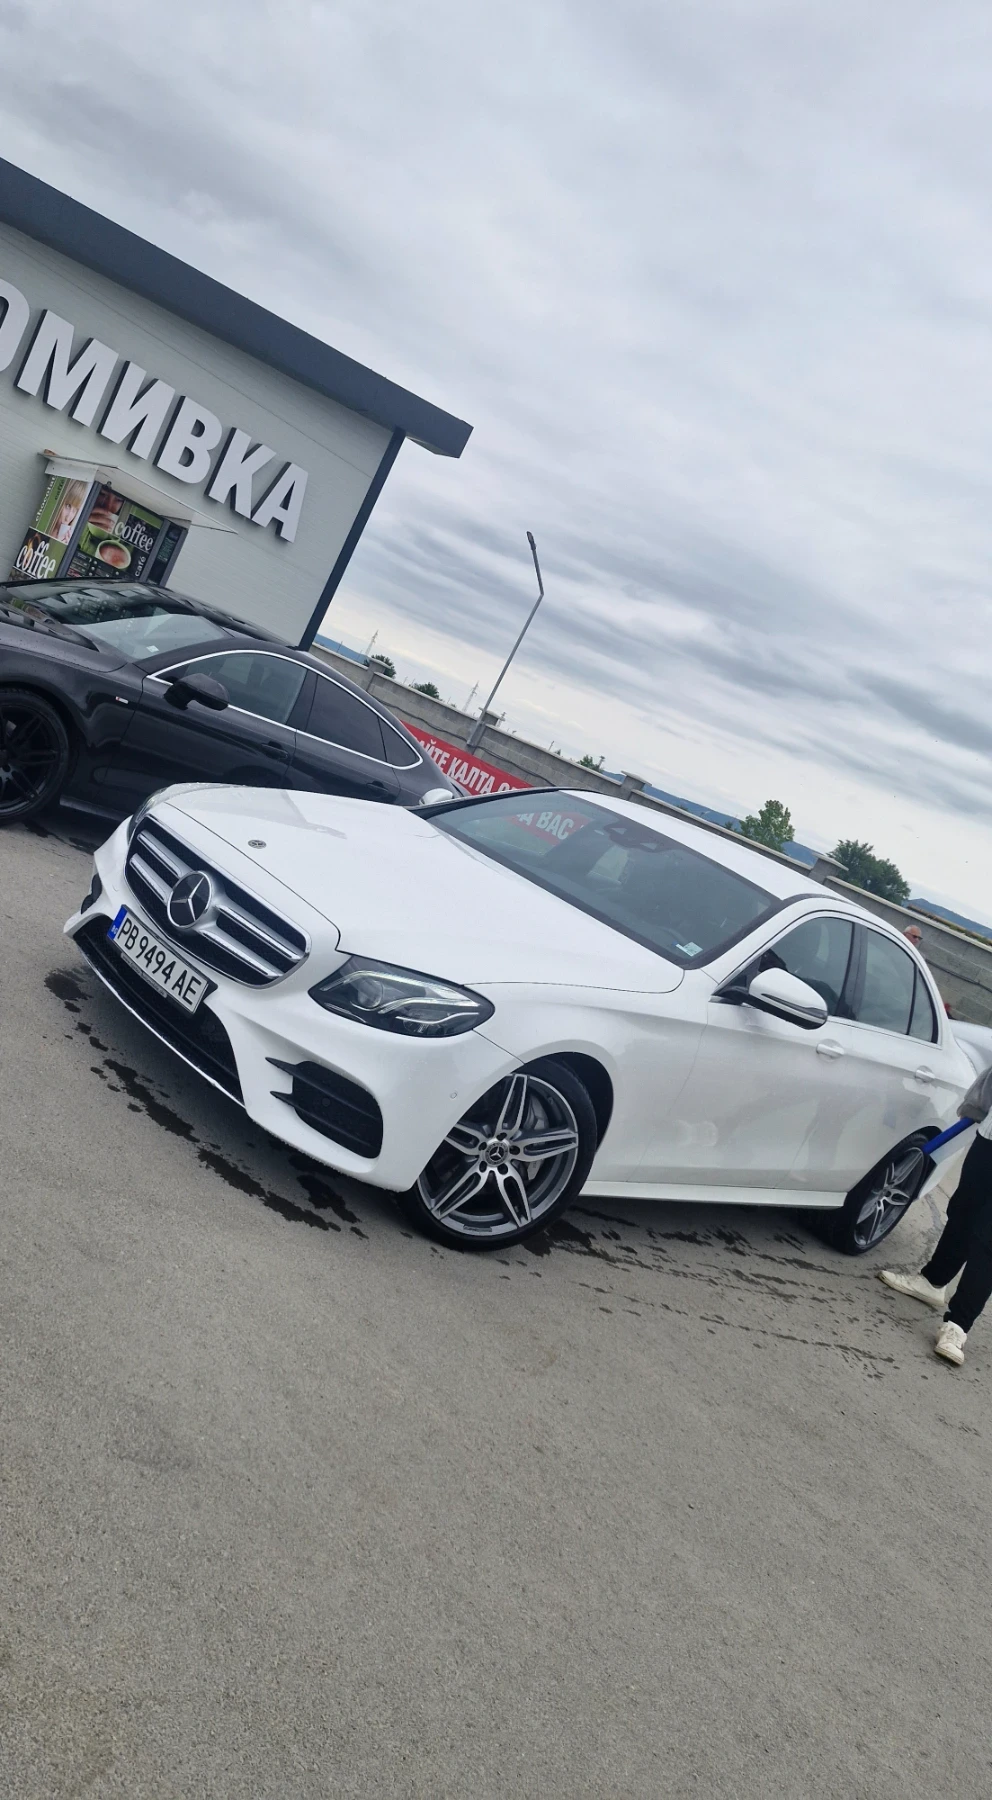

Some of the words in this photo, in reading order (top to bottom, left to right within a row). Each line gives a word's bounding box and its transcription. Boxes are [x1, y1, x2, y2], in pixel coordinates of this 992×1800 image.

[114, 521, 154, 551] coffee
[16, 540, 57, 579] coffee
[134, 556, 146, 577] café
[447, 756, 496, 794] КАЛТА
[535, 811, 575, 840] ВАС
[117, 917, 139, 951] PB
[135, 935, 177, 985] 9494
[171, 969, 202, 1006] AE
